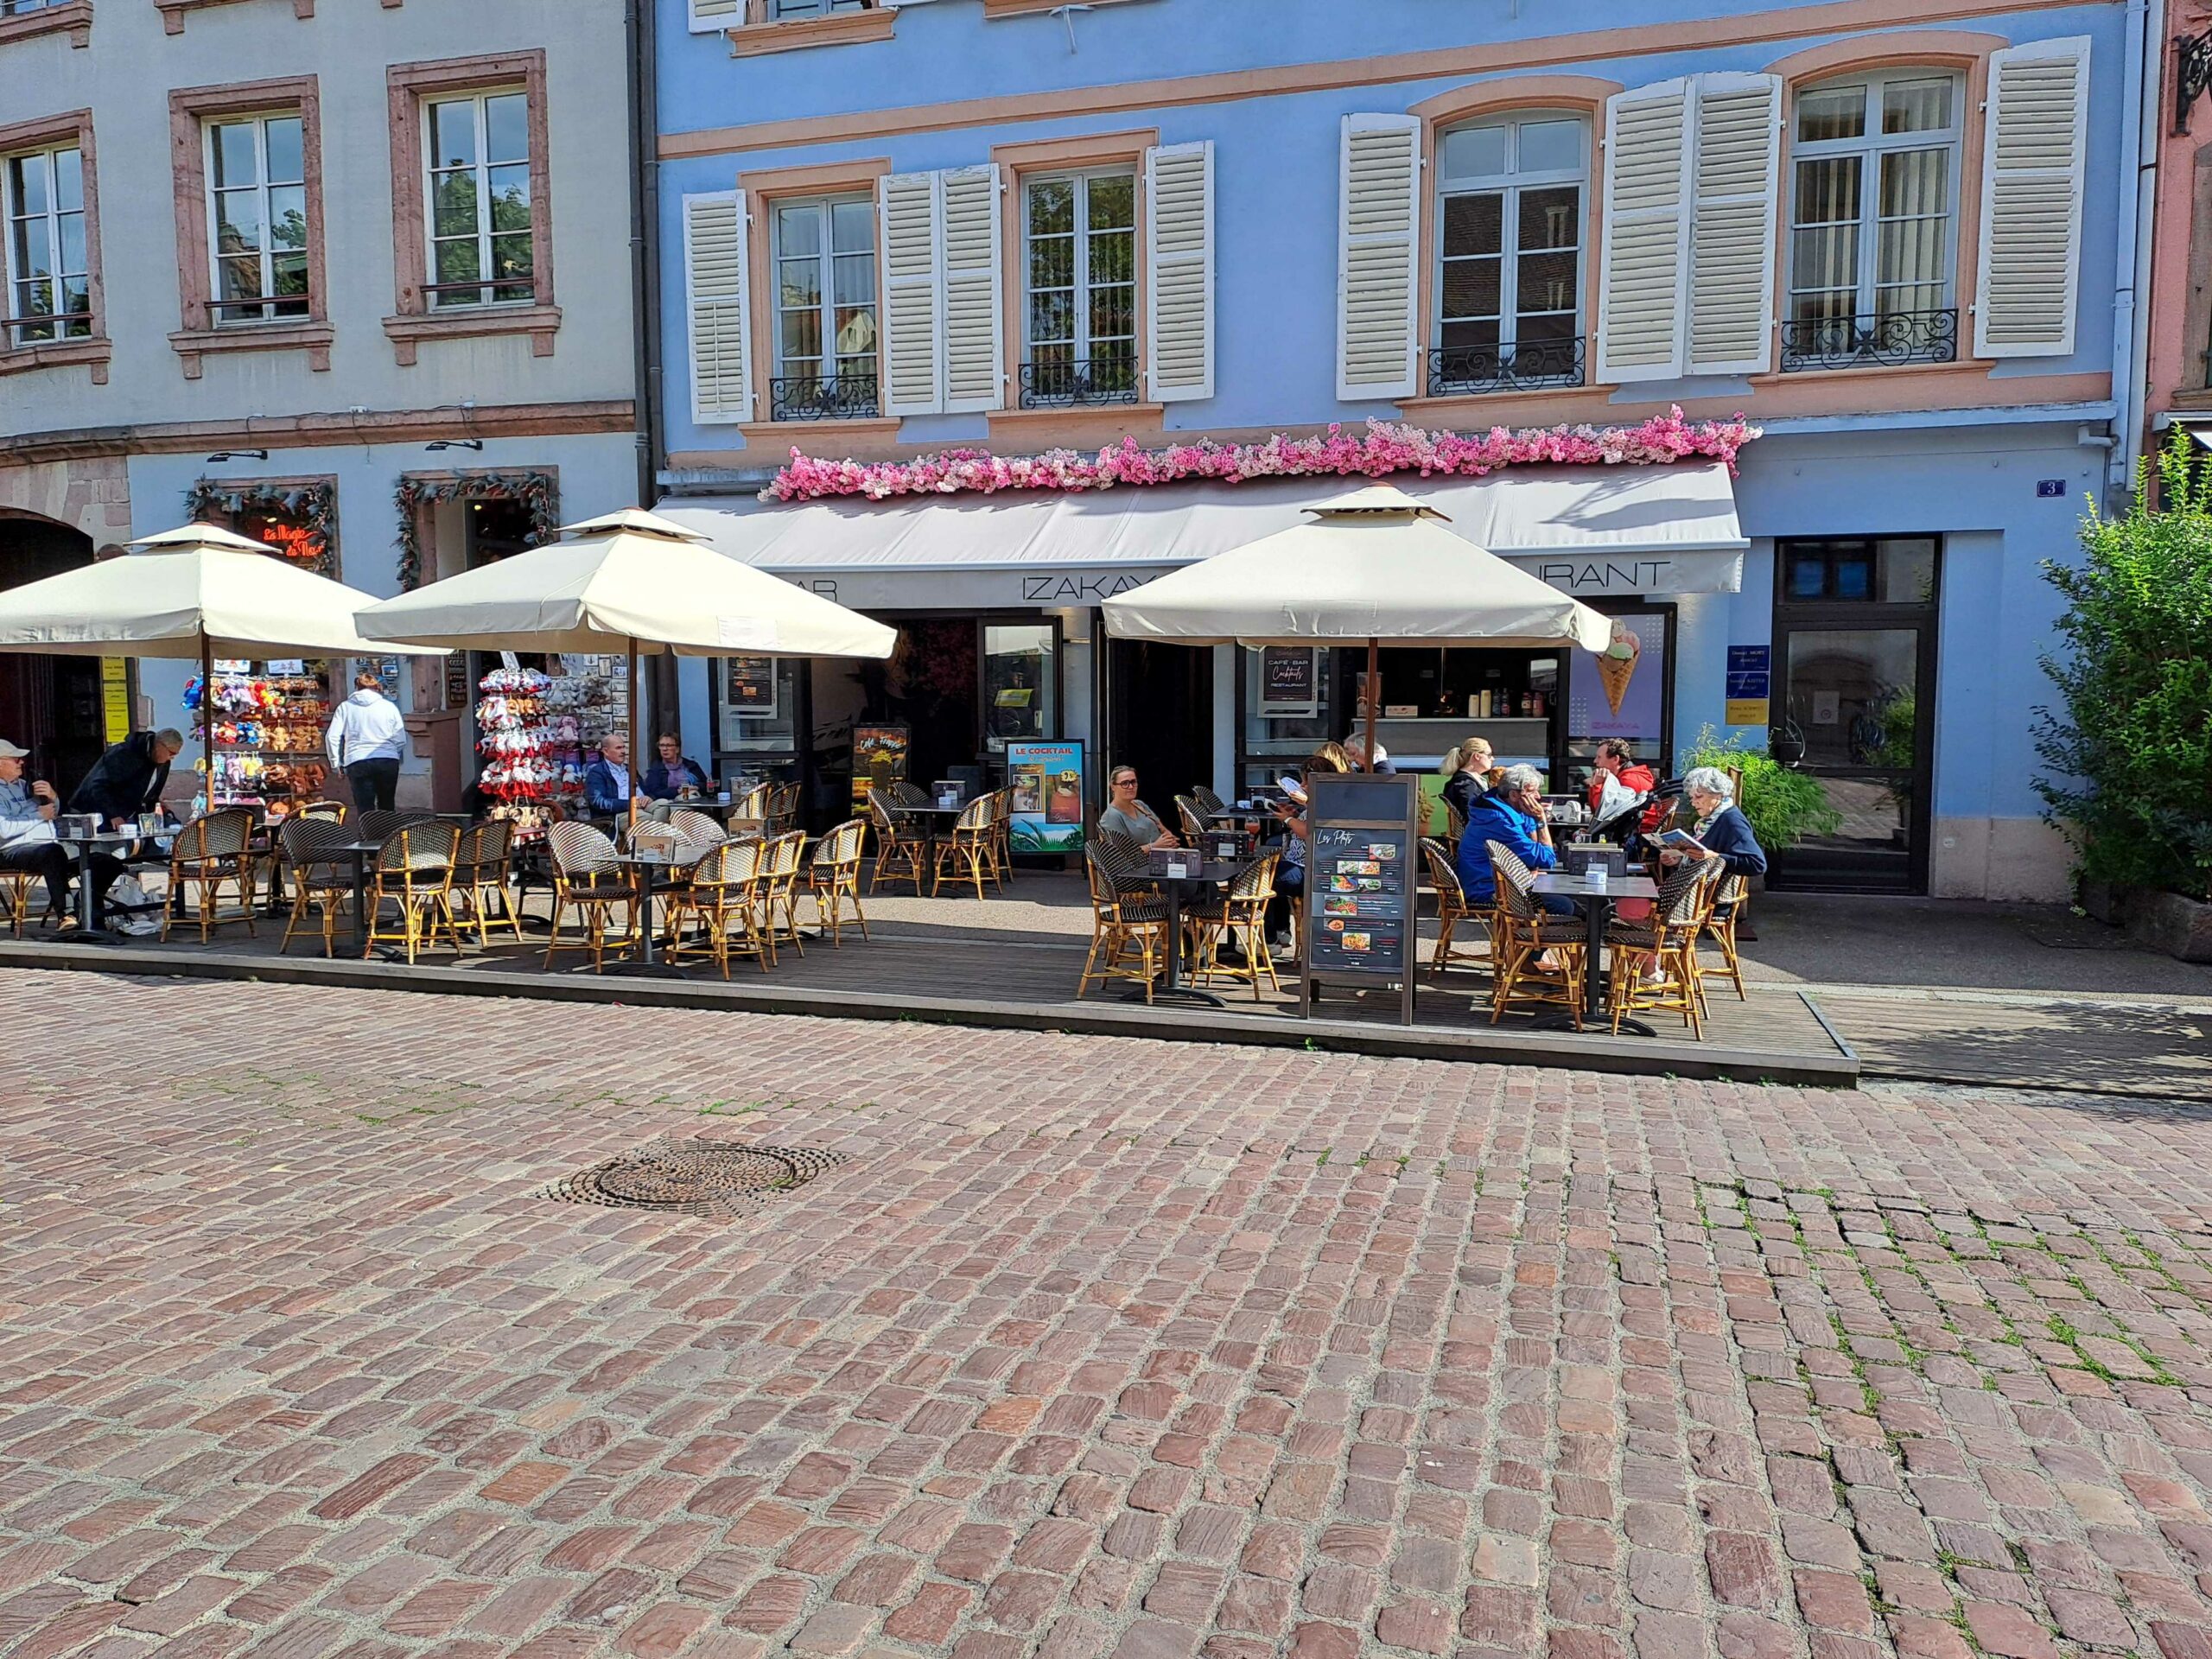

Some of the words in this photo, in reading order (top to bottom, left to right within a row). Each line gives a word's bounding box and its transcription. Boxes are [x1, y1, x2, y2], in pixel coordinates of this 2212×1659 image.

[2048, 482, 2056, 494] 3
[264, 529, 276, 540] La
[286, 545, 297, 556] de
[1317, 830, 1332, 844] Les
[1333, 830, 1356, 847] Plats
